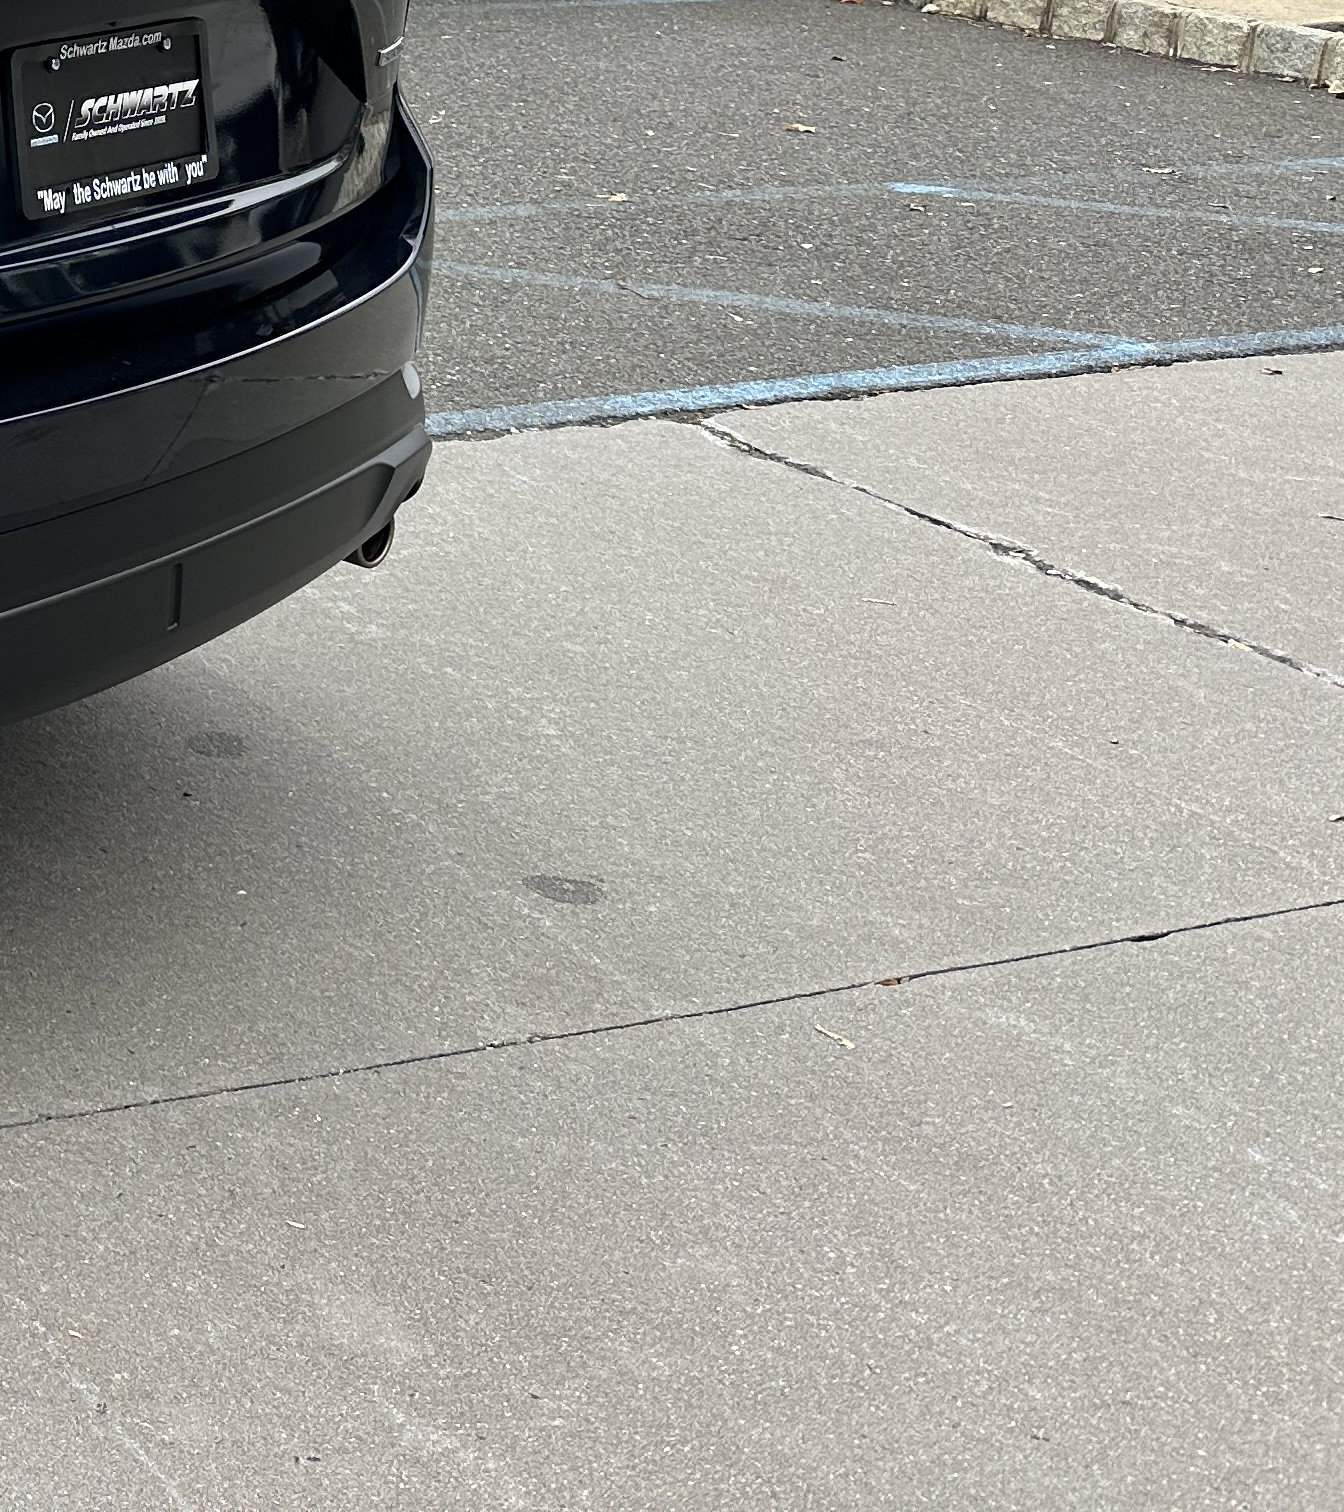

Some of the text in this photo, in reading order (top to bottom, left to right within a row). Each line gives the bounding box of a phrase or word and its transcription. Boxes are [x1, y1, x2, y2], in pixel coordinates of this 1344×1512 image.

[60, 40, 107, 60] Schwartz
[74, 79, 200, 129] SCHWARTZ
[37, 154, 208, 214] "May the Schwartz be with you"
